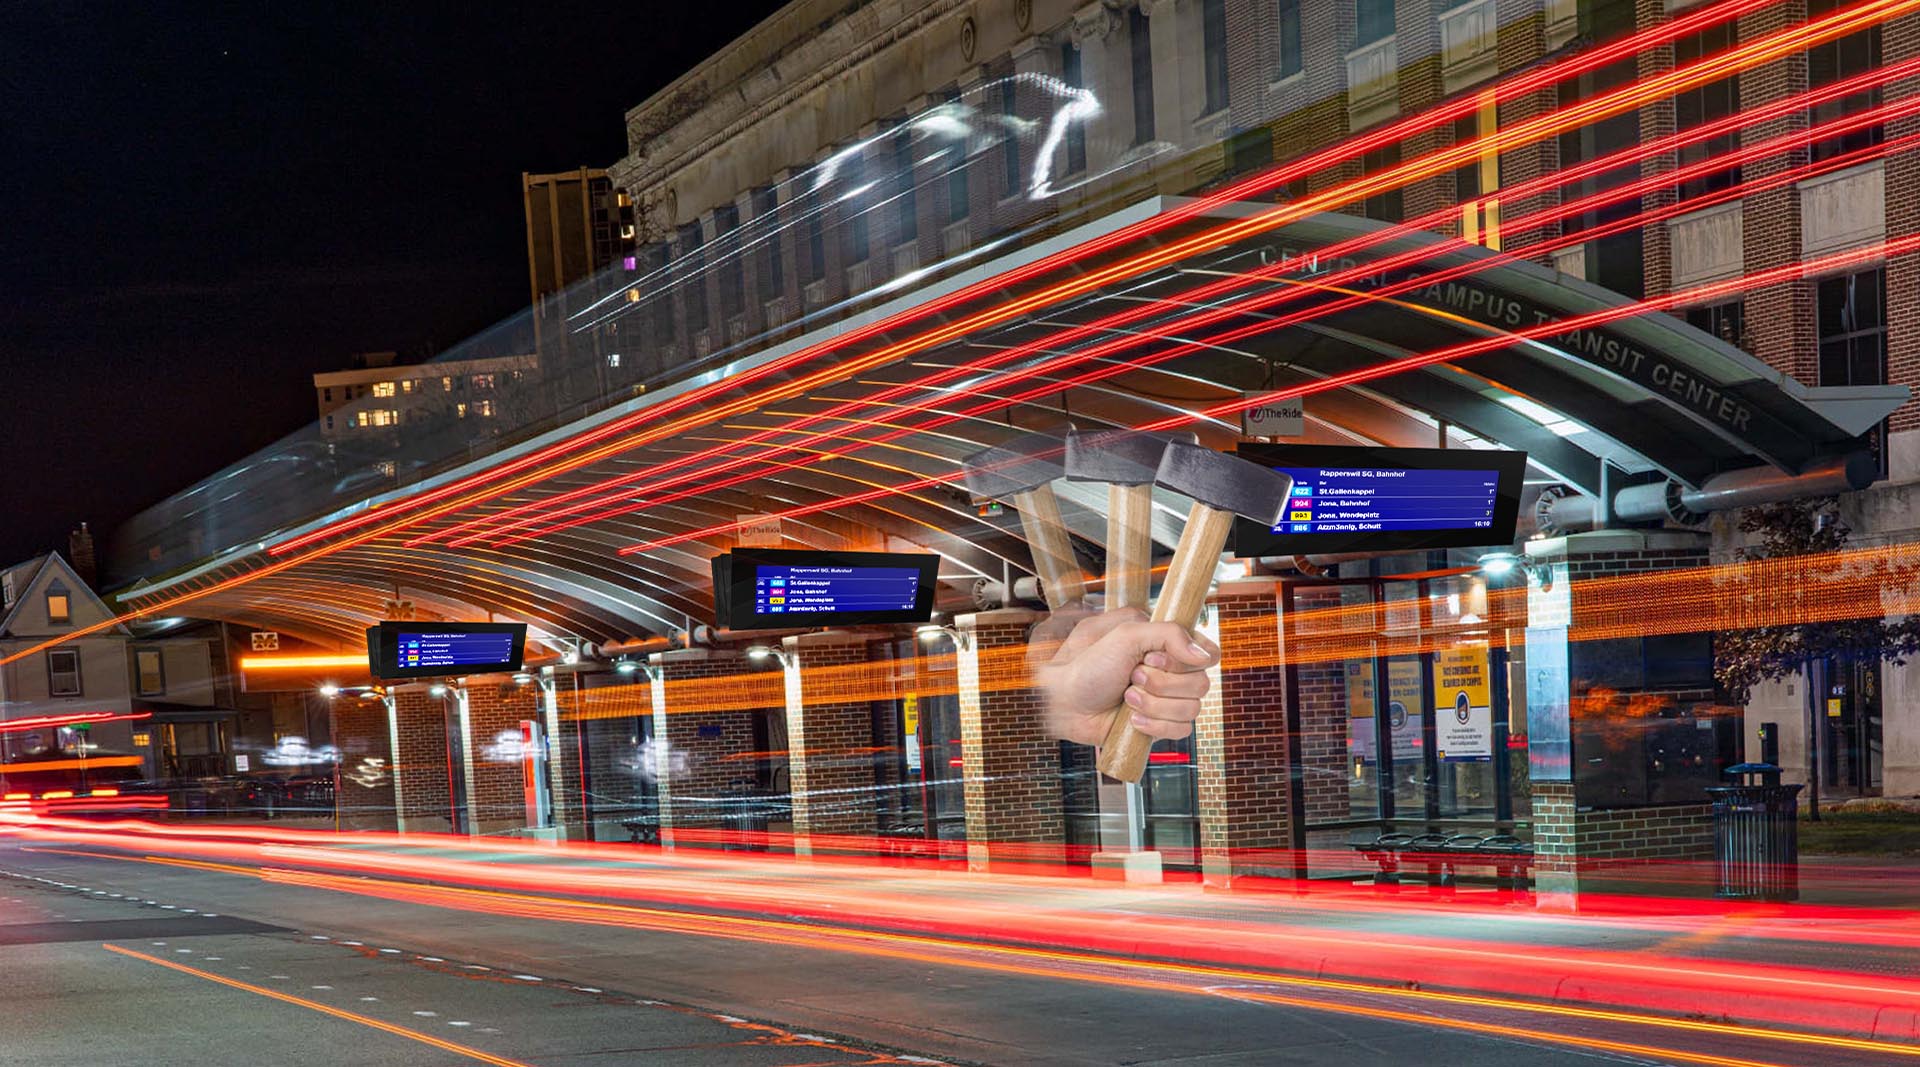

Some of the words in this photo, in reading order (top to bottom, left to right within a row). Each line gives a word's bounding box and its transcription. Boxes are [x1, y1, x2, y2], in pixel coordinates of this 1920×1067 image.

[1407, 272, 1522, 325] CAMPUS
[1652, 364, 1751, 432] CENTER
[1265, 407, 1303, 419] TheRide
[1376, 470, 1406, 478] Bahnhof
[1340, 499, 1371, 507] Bahnhof
